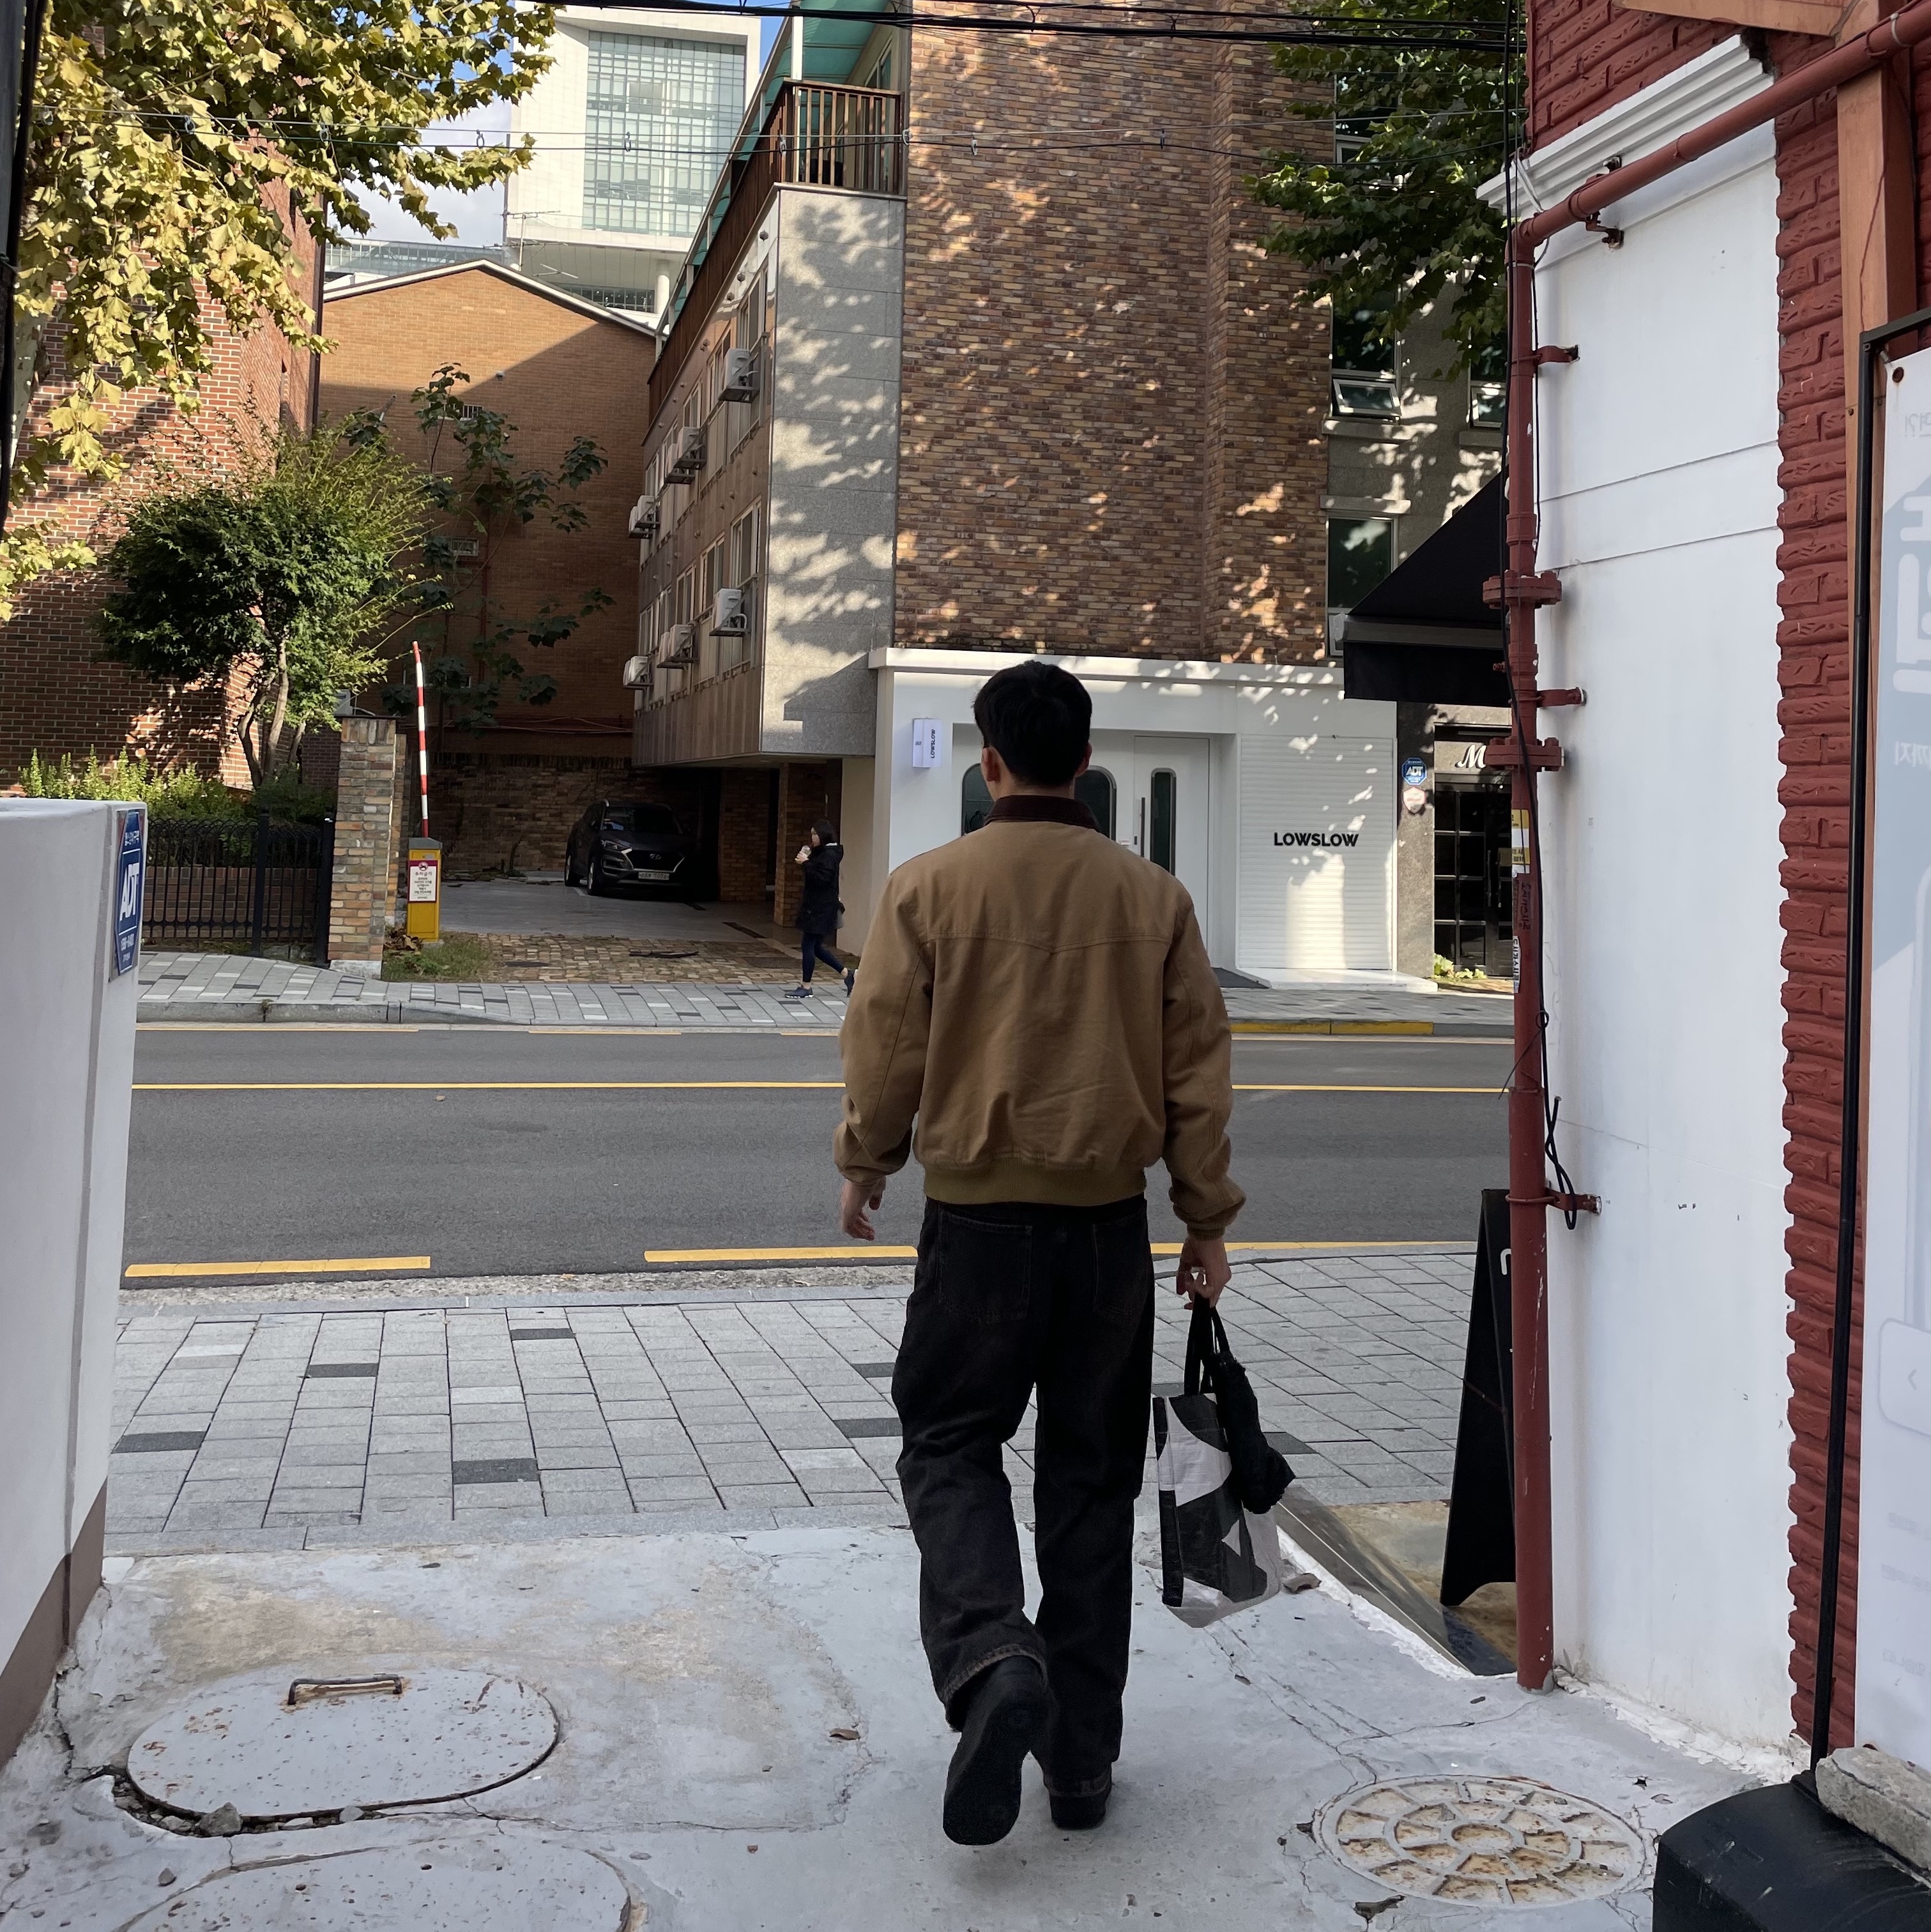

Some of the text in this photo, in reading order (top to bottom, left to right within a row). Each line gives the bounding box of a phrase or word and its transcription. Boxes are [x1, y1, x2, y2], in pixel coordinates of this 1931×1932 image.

[1405, 766, 1424, 777] ADT
[1274, 832, 1359, 848] LOWSLOW
[119, 861, 141, 922] ADT
